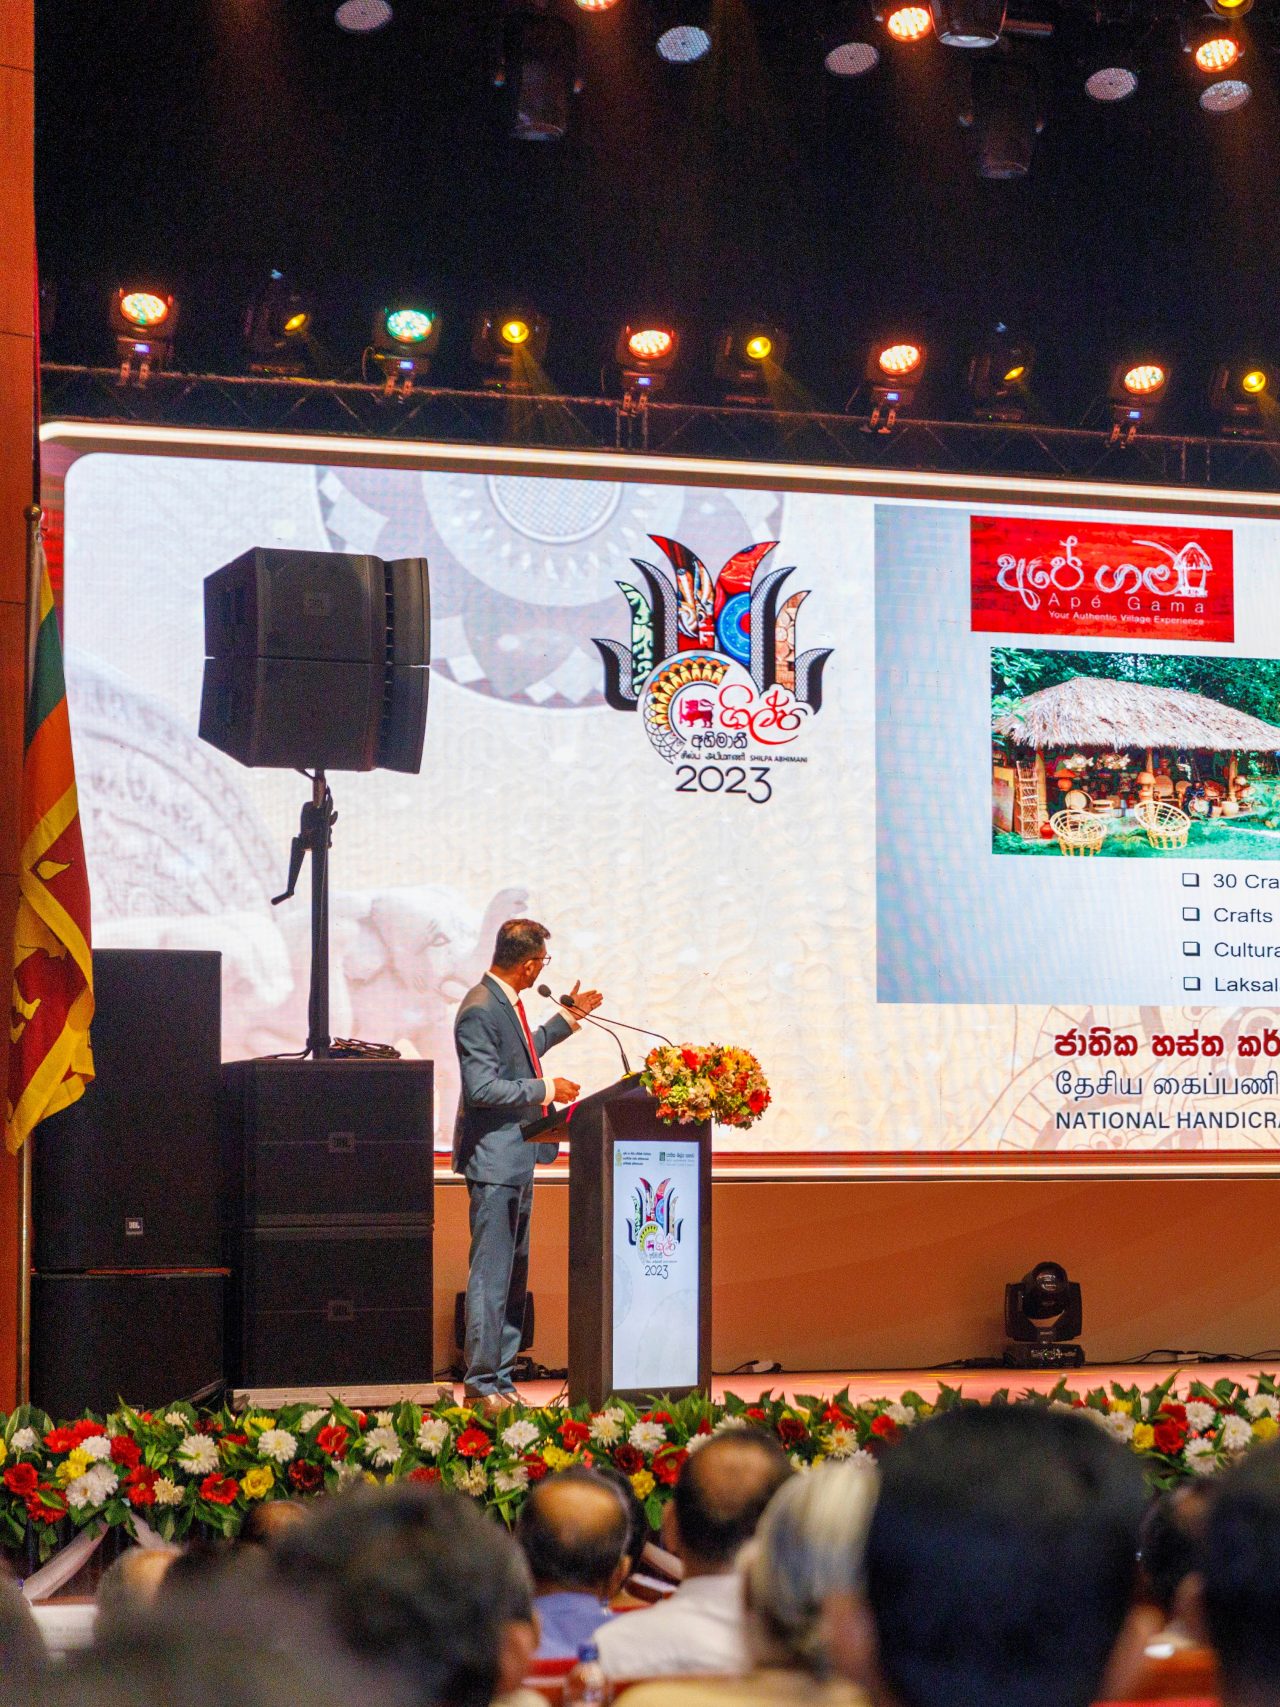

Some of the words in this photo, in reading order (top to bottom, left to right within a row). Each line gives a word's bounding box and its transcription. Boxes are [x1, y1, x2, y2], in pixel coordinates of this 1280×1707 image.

[996, 535, 1085, 611] අපේ
[1048, 593, 1101, 608] Apé
[1128, 596, 1204, 613] Gama
[1049, 610, 1069, 620] Your
[1073, 611, 1117, 622] Authentic
[1121, 614, 1150, 624] Village
[1154, 615, 1204, 626] Experience
[676, 765, 772, 804] 2023
[1213, 873, 1237, 888] 30
[1213, 907, 1273, 923] Crafts
[1053, 1026, 1138, 1057] ජාතික
[1151, 1028, 1224, 1057] හස්ත
[1055, 1070, 1142, 1101] தேசிய
[1153, 1070, 1278, 1095] கைப்பணி
[1056, 1111, 1170, 1130] NATIONAL
[645, 1265, 669, 1279] 2023
